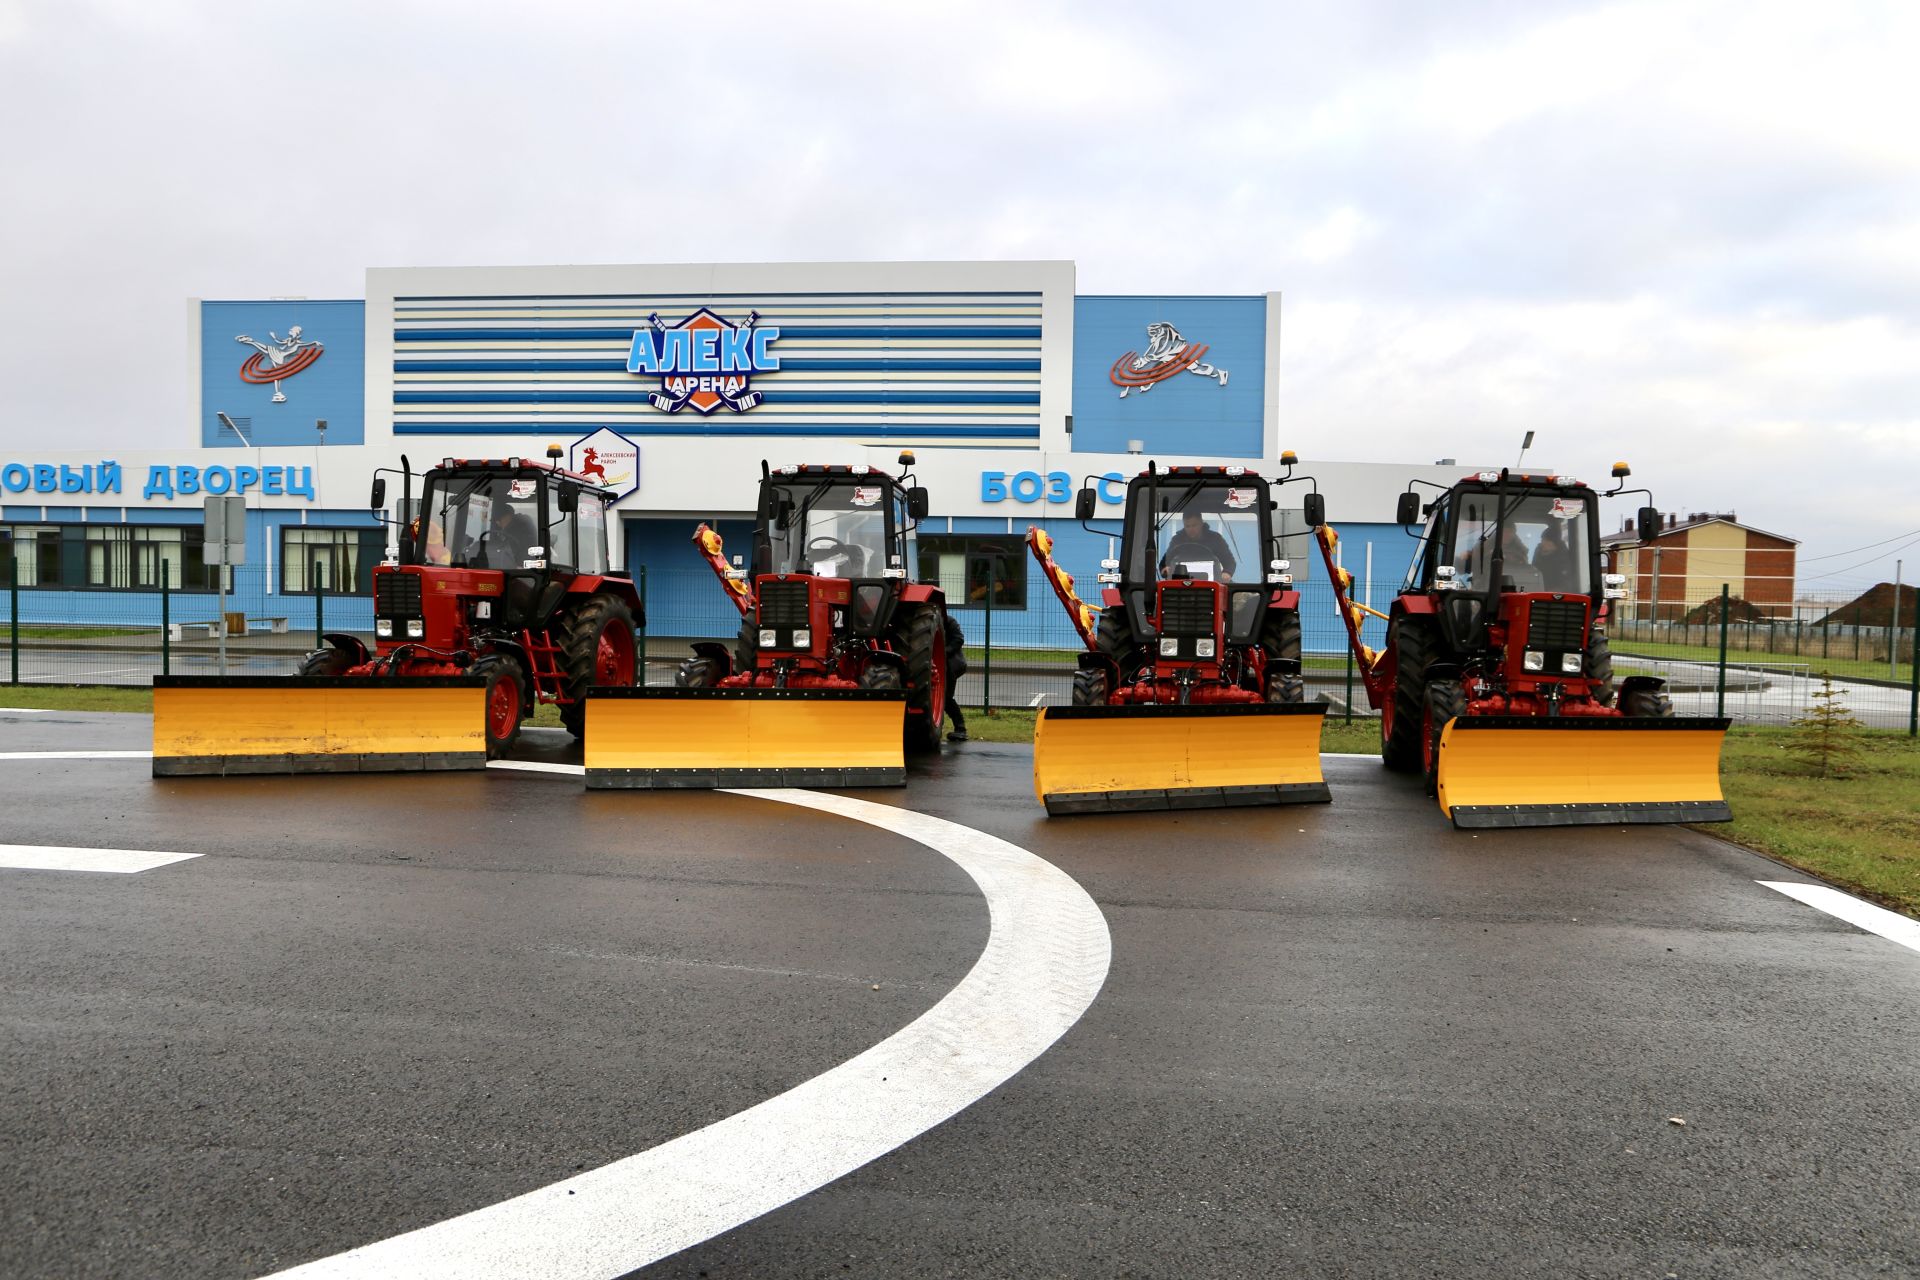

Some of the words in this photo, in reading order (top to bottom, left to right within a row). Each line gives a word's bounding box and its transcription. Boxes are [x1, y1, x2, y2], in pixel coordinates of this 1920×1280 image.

[626, 327, 780, 372] АЛЕКС
[670, 376, 741, 393] АРЕНА
[0, 460, 122, 494] ОВЫЙ
[143, 464, 315, 500] ДВОРЕЦ
[981, 471, 1073, 503] БОЗ
[1097, 472, 1125, 504] С
